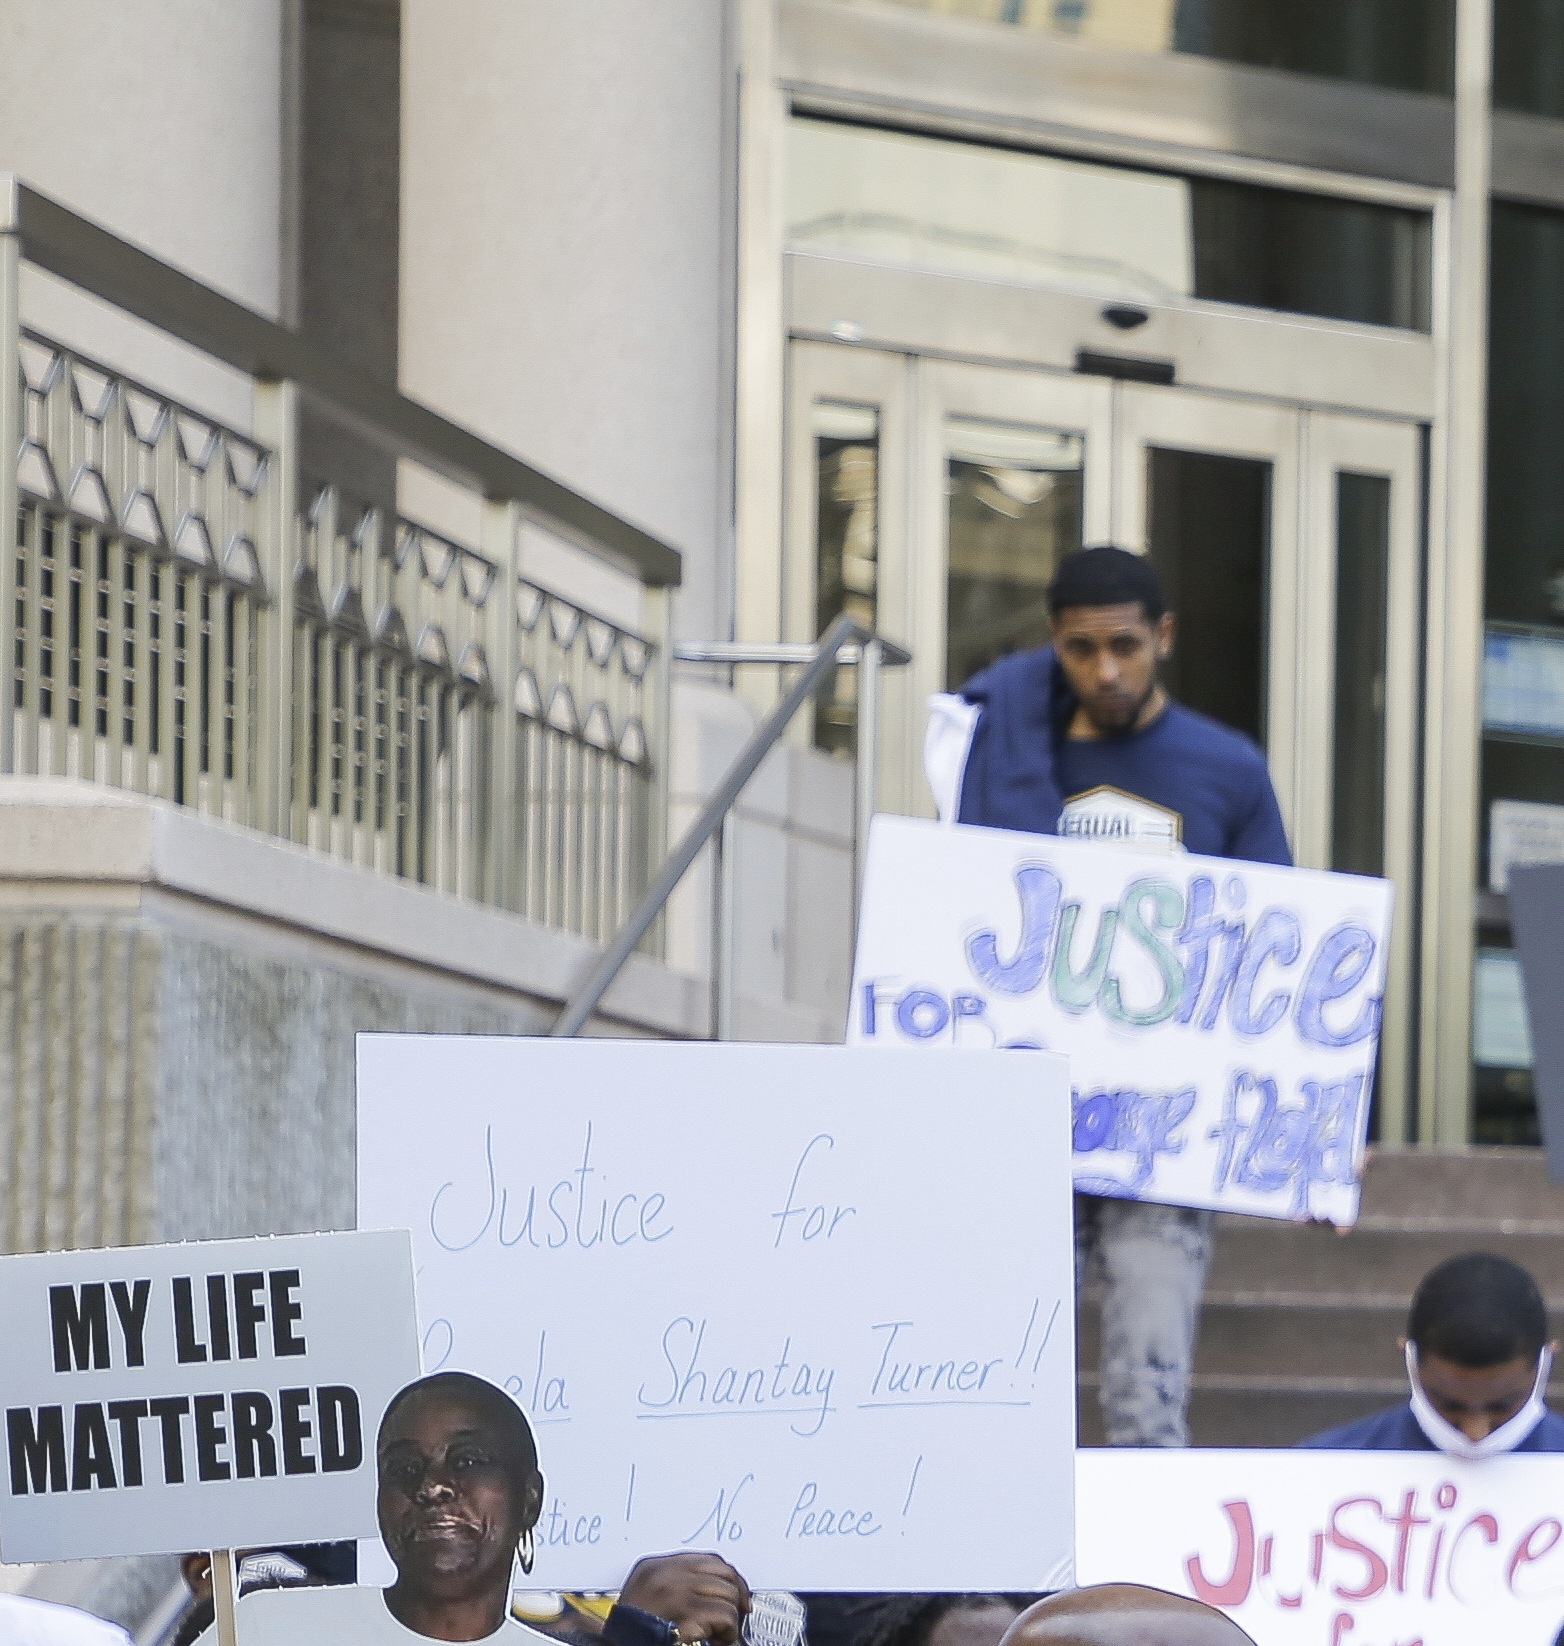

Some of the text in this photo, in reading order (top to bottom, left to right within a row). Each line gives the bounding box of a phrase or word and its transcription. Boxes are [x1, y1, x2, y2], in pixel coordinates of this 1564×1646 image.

[430, 1121, 856, 1252] Justice for
[48, 1267, 306, 1373] MY LIFE
[423, 1318, 570, 1412] Pela
[637, 1317, 835, 1436] Shantay
[6, 1384, 364, 1496] MATTERED
[682, 1475, 744, 1543] No
